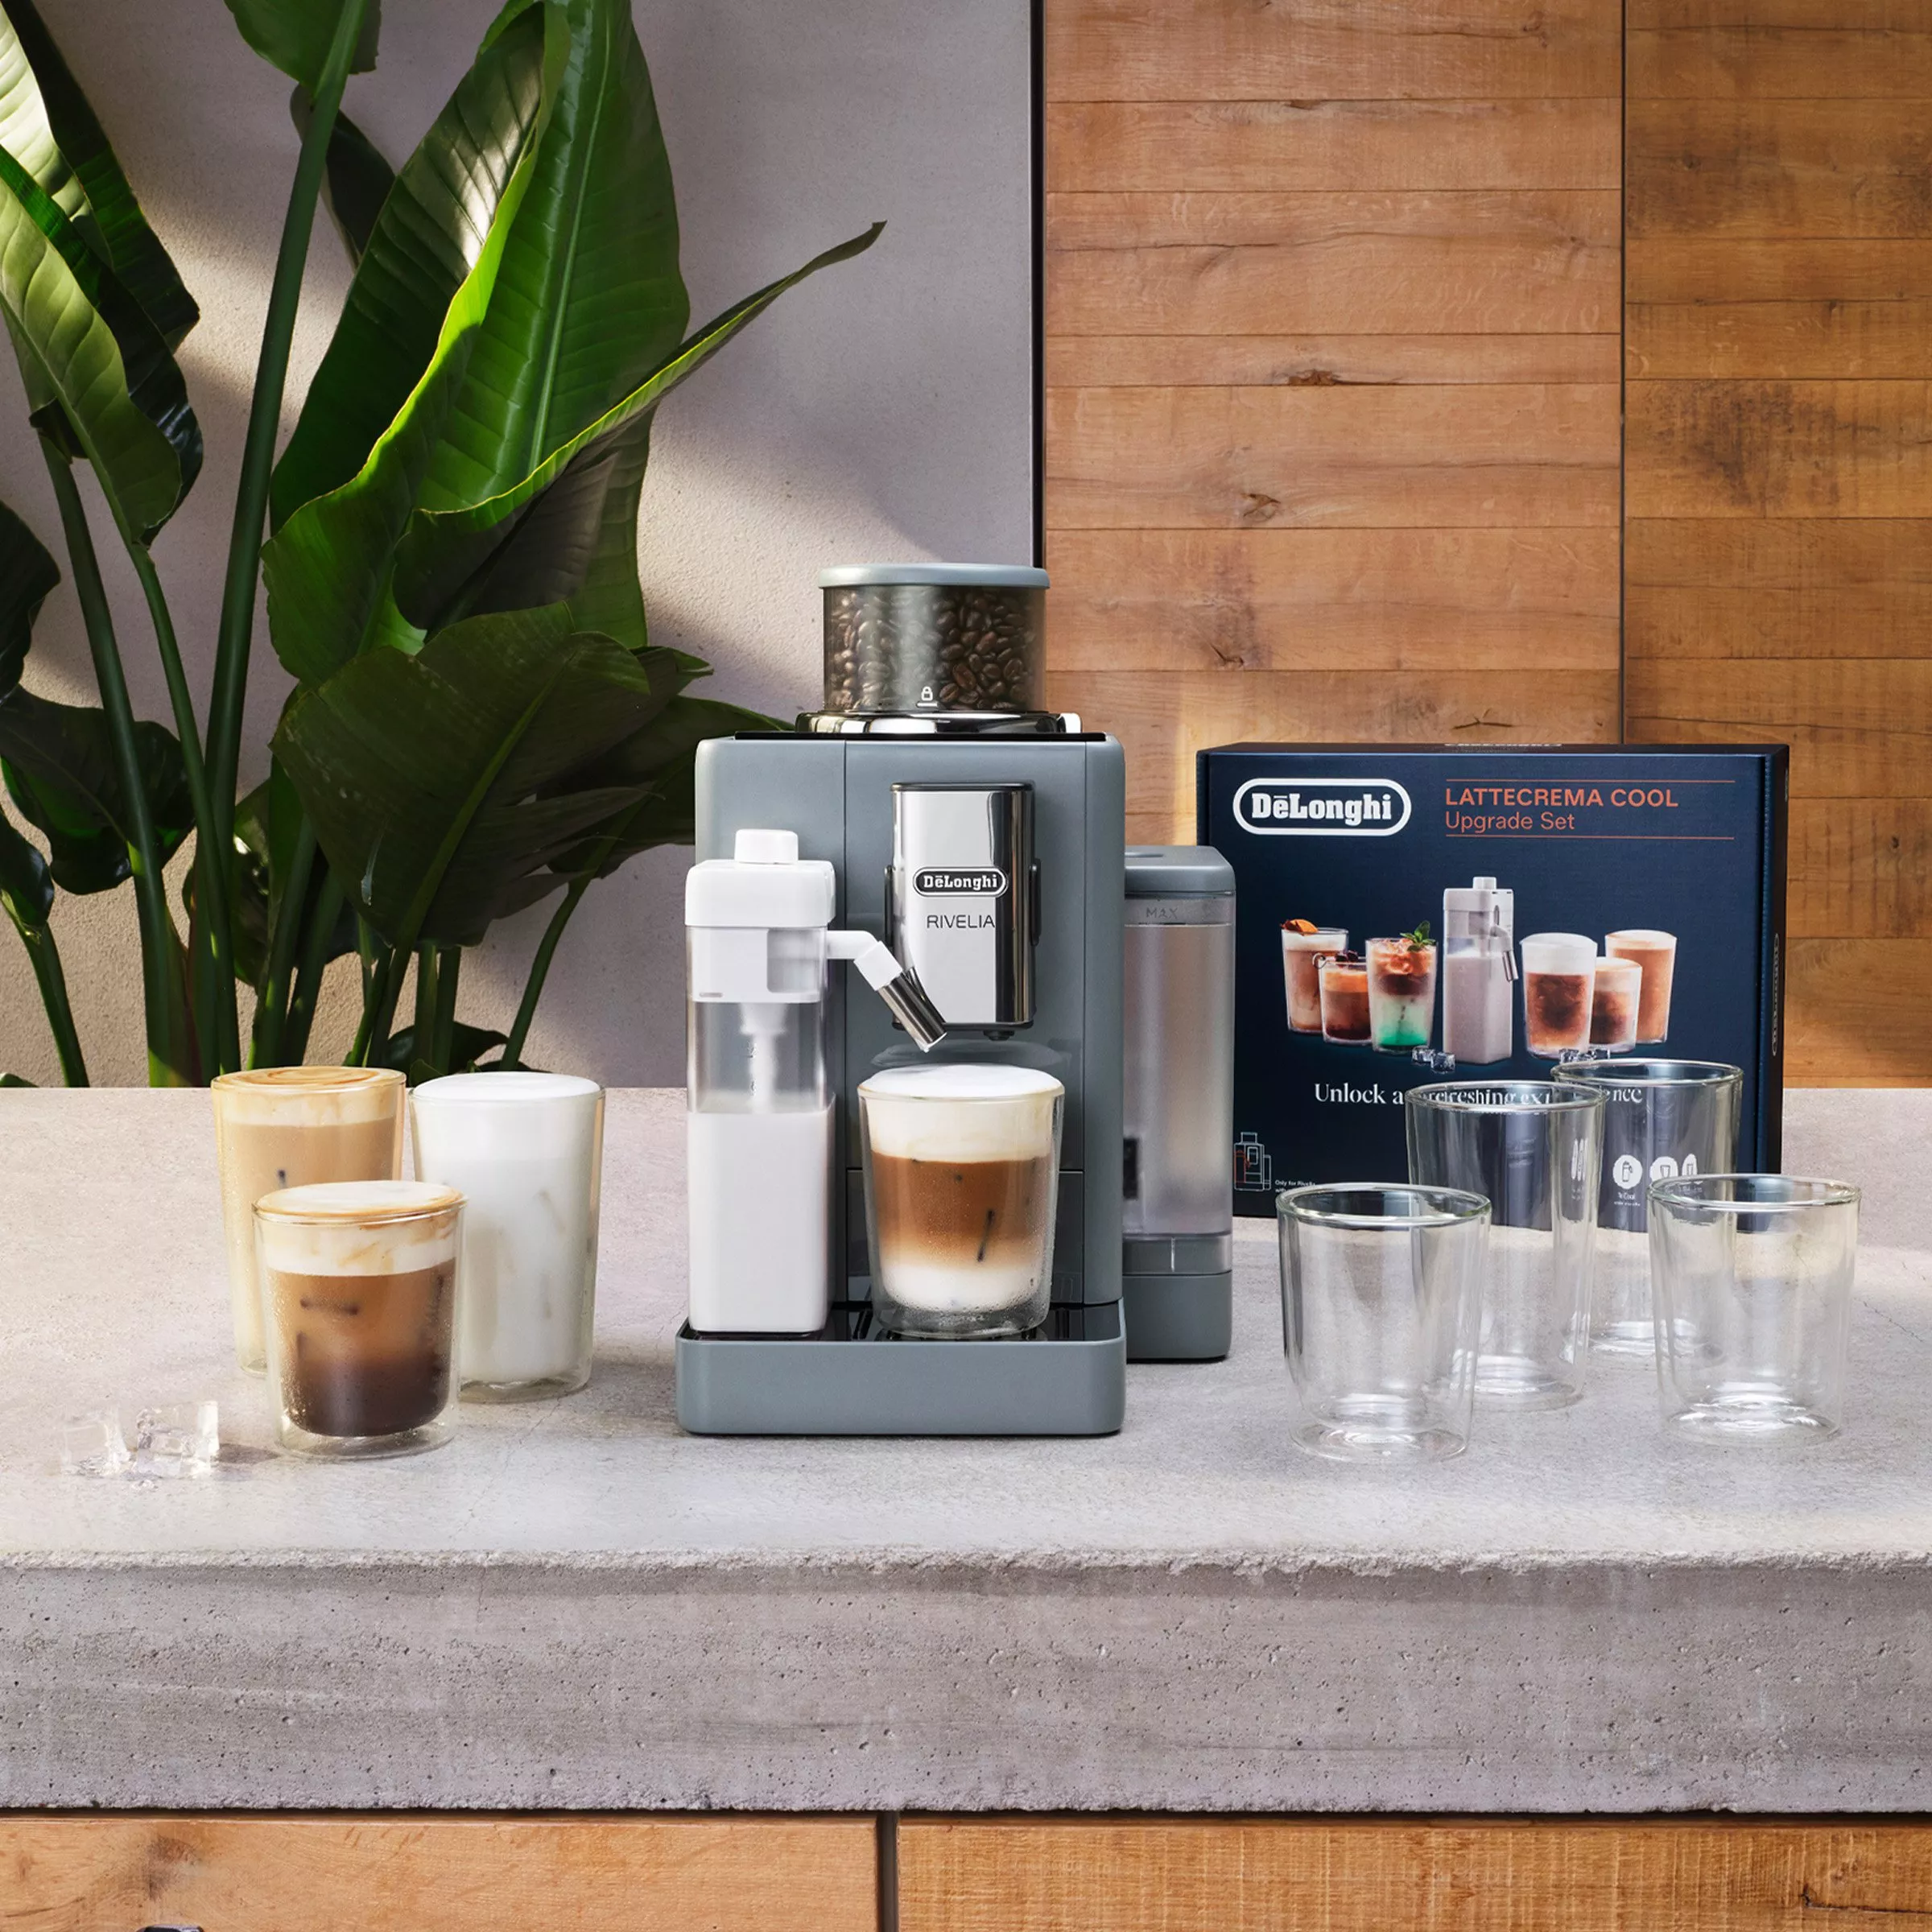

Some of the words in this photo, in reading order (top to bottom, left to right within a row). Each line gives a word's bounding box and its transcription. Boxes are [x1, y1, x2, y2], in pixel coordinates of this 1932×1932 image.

[1446, 787, 1604, 807] LATTECREMA
[1610, 788, 1679, 807] COOL
[1445, 811, 1534, 834] Upgrade
[1540, 811, 1575, 830] Set
[926, 914, 996, 929] RIVELIA
[1146, 906, 1179, 919] MAX
[1314, 1082, 1387, 1104] Unlock
[1392, 1090, 1405, 1105] a
